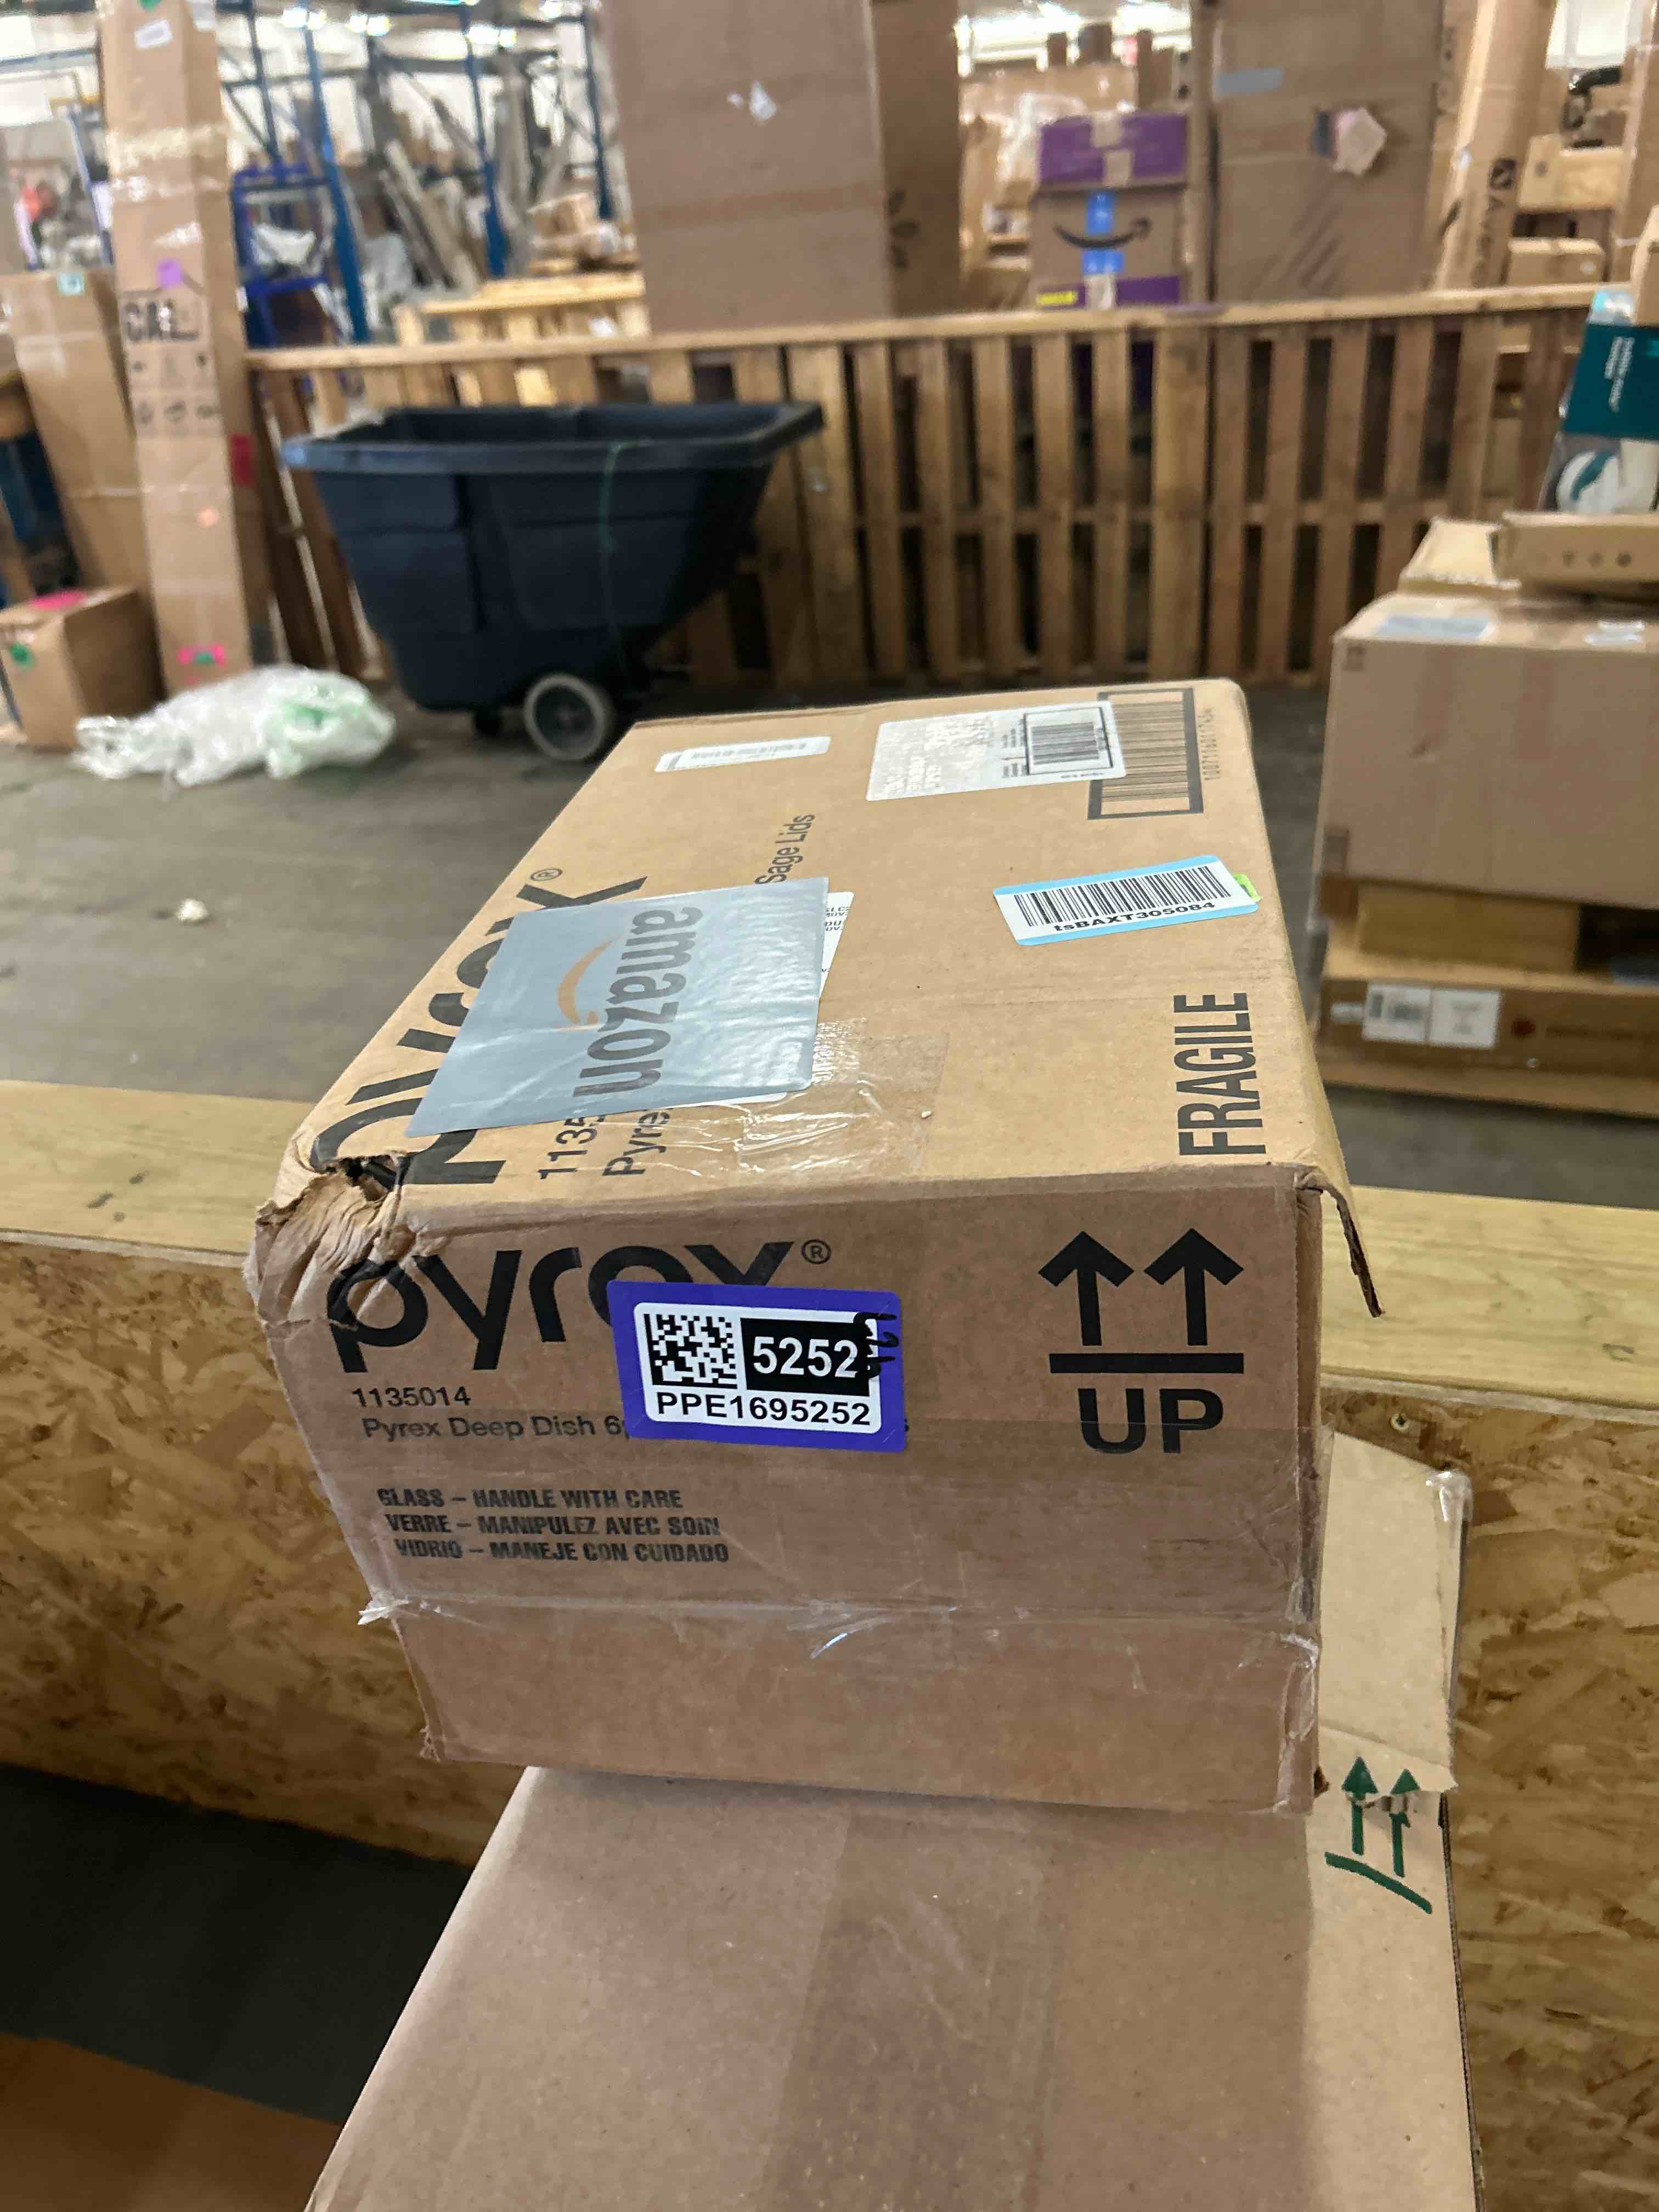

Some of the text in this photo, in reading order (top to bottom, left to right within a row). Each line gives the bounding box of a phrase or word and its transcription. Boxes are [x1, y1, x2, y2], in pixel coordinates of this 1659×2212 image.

[755, 815, 815, 884] Sage Lids
[1054, 902, 1216, 932] tsBAXT305084
[573, 907, 703, 1098] amazon
[1173, 992, 1266, 1156] FRAGILE
[602, 1108, 674, 1176] Pyre
[752, 1336, 859, 1379] 5252
[351, 1386, 471, 1408] 1135014
[657, 1392, 871, 1426] PPE1695252
[361, 1417, 443, 1442] Pyrex
[448, 1417, 524, 1441] Deep
[531, 1414, 596, 1437] Dish
[1077, 1387, 1224, 1454] UP
[377, 1487, 445, 1508] GLASS
[472, 1488, 557, 1508] HANDLE
[560, 1489, 620, 1509] WITH
[625, 1489, 684, 1509] CARE
[385, 1514, 452, 1533] VERRE
[478, 1516, 599, 1534] MANIPULEZ
[605, 1516, 661, 1535] AVEC
[667, 1516, 721, 1536] SOIN
[393, 1539, 463, 1559] VIDRIO
[489, 1542, 579, 1561] MANEJE
[583, 1542, 630, 1562] CON
[633, 1543, 730, 1563] CUIDADO
